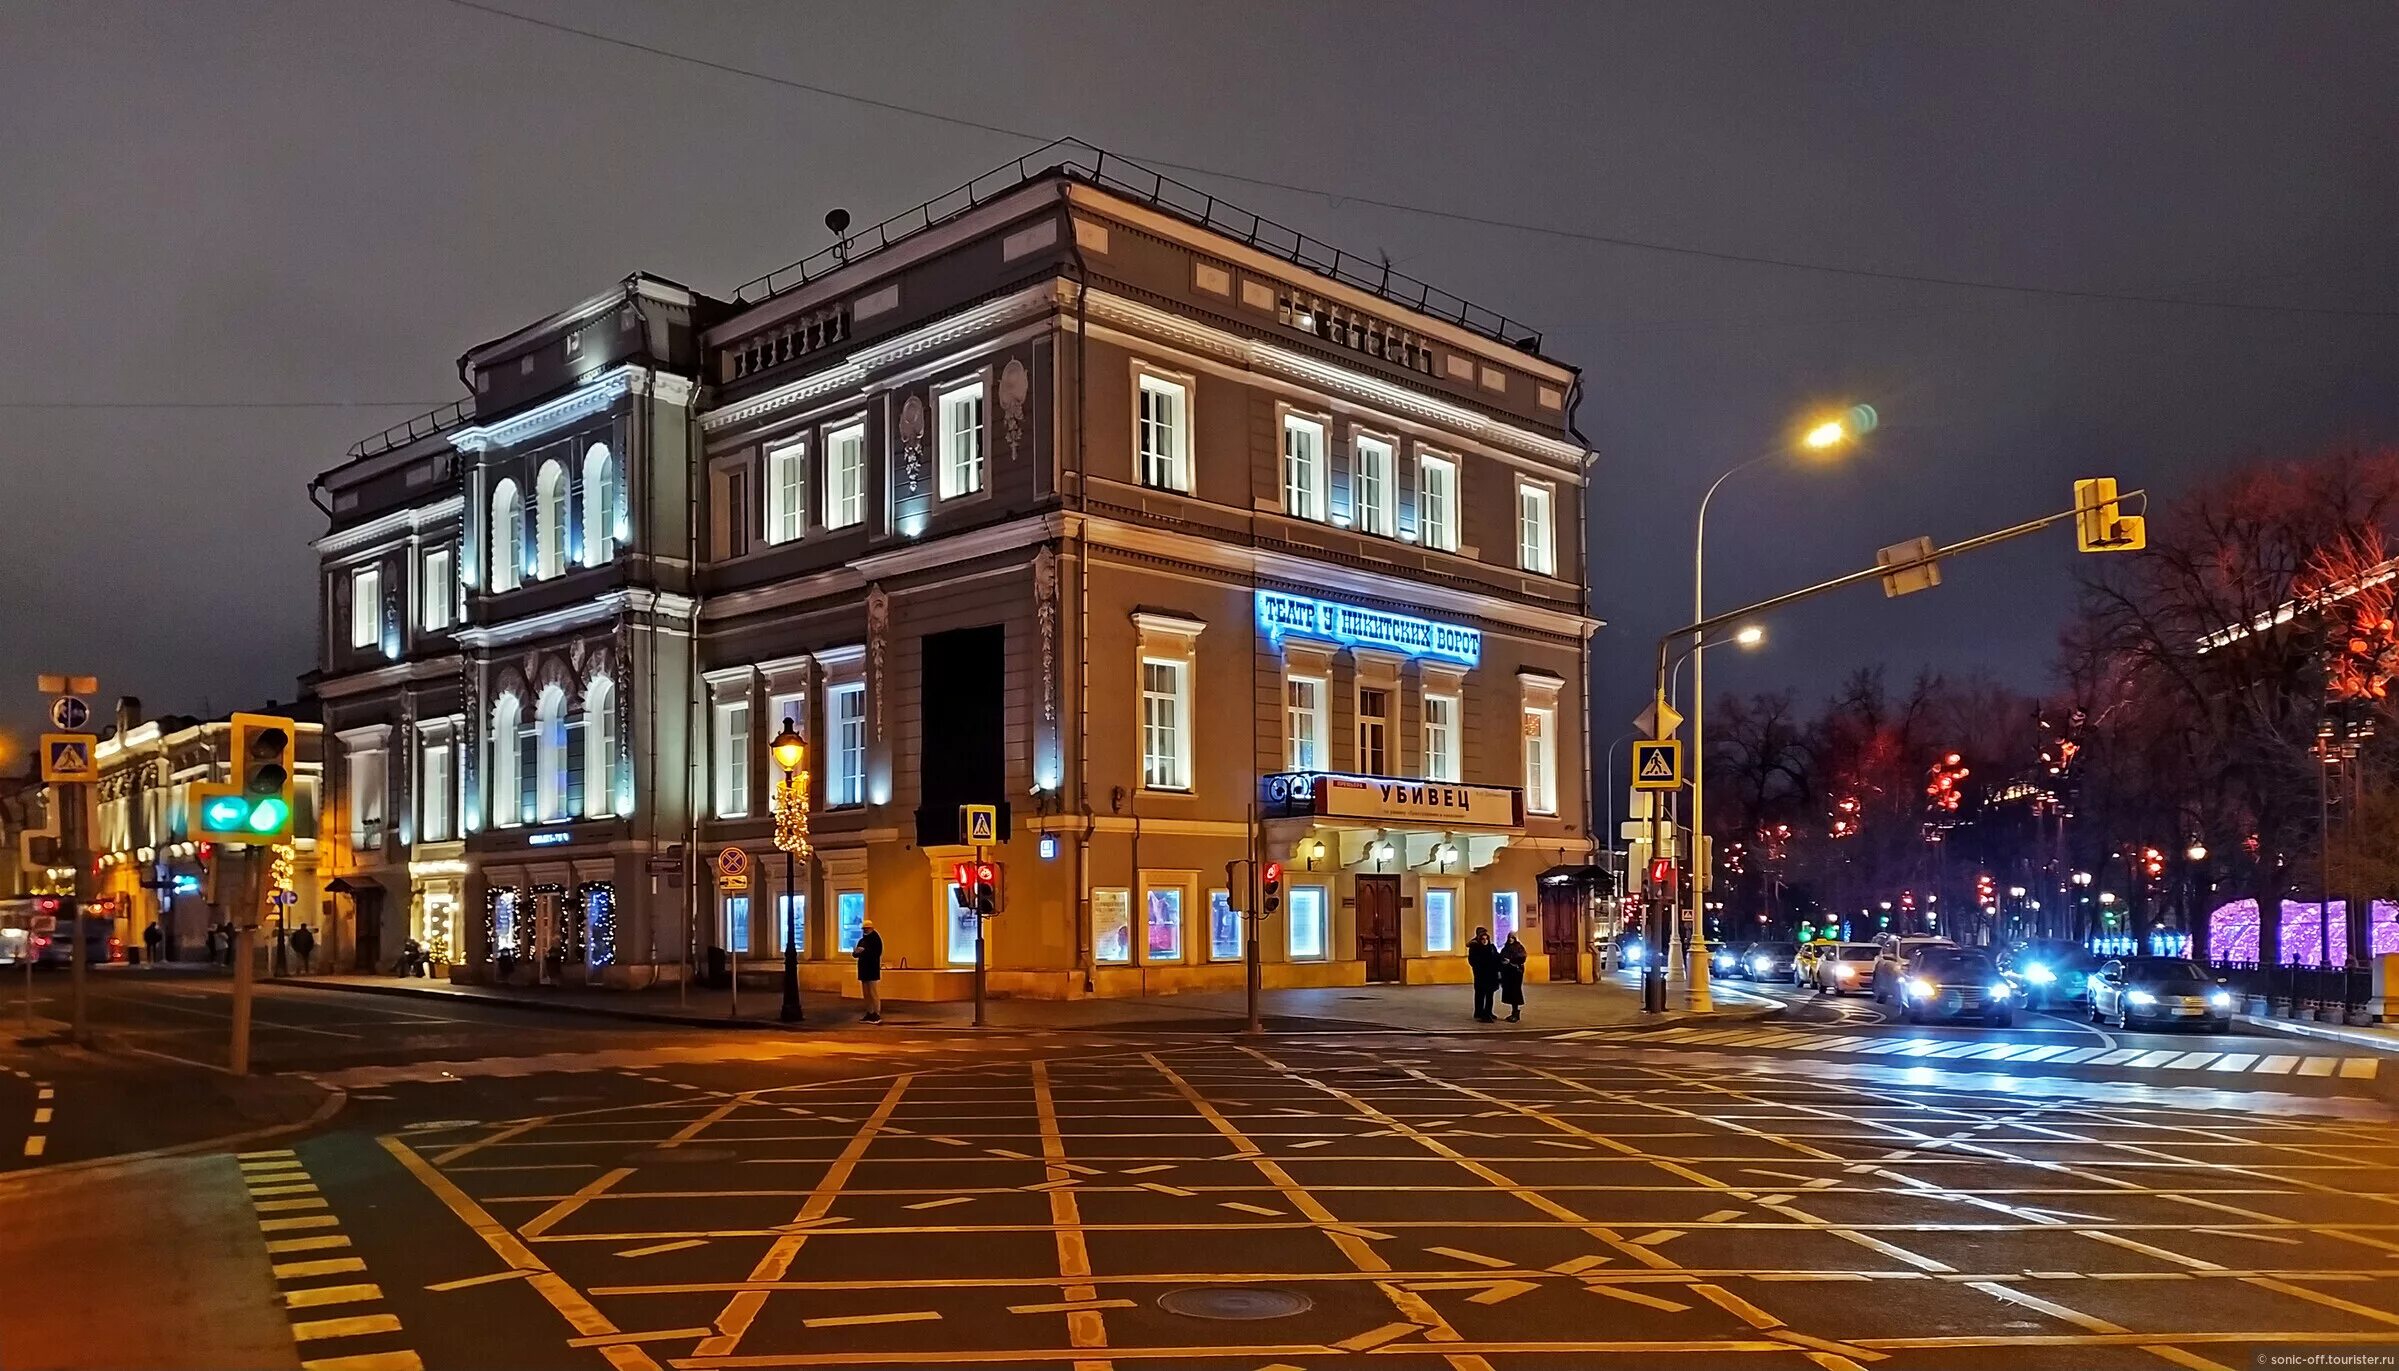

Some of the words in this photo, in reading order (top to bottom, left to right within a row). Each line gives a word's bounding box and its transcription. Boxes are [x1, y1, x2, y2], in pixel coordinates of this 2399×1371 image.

[1265, 596, 1315, 627] ТЕАТР
[1323, 606, 1334, 630] У
[1341, 610, 1431, 647] НИКИТСКИХ
[1437, 627, 1479, 655] ВОРОТ
[1379, 784, 1470, 811] УБИВЕЦ
